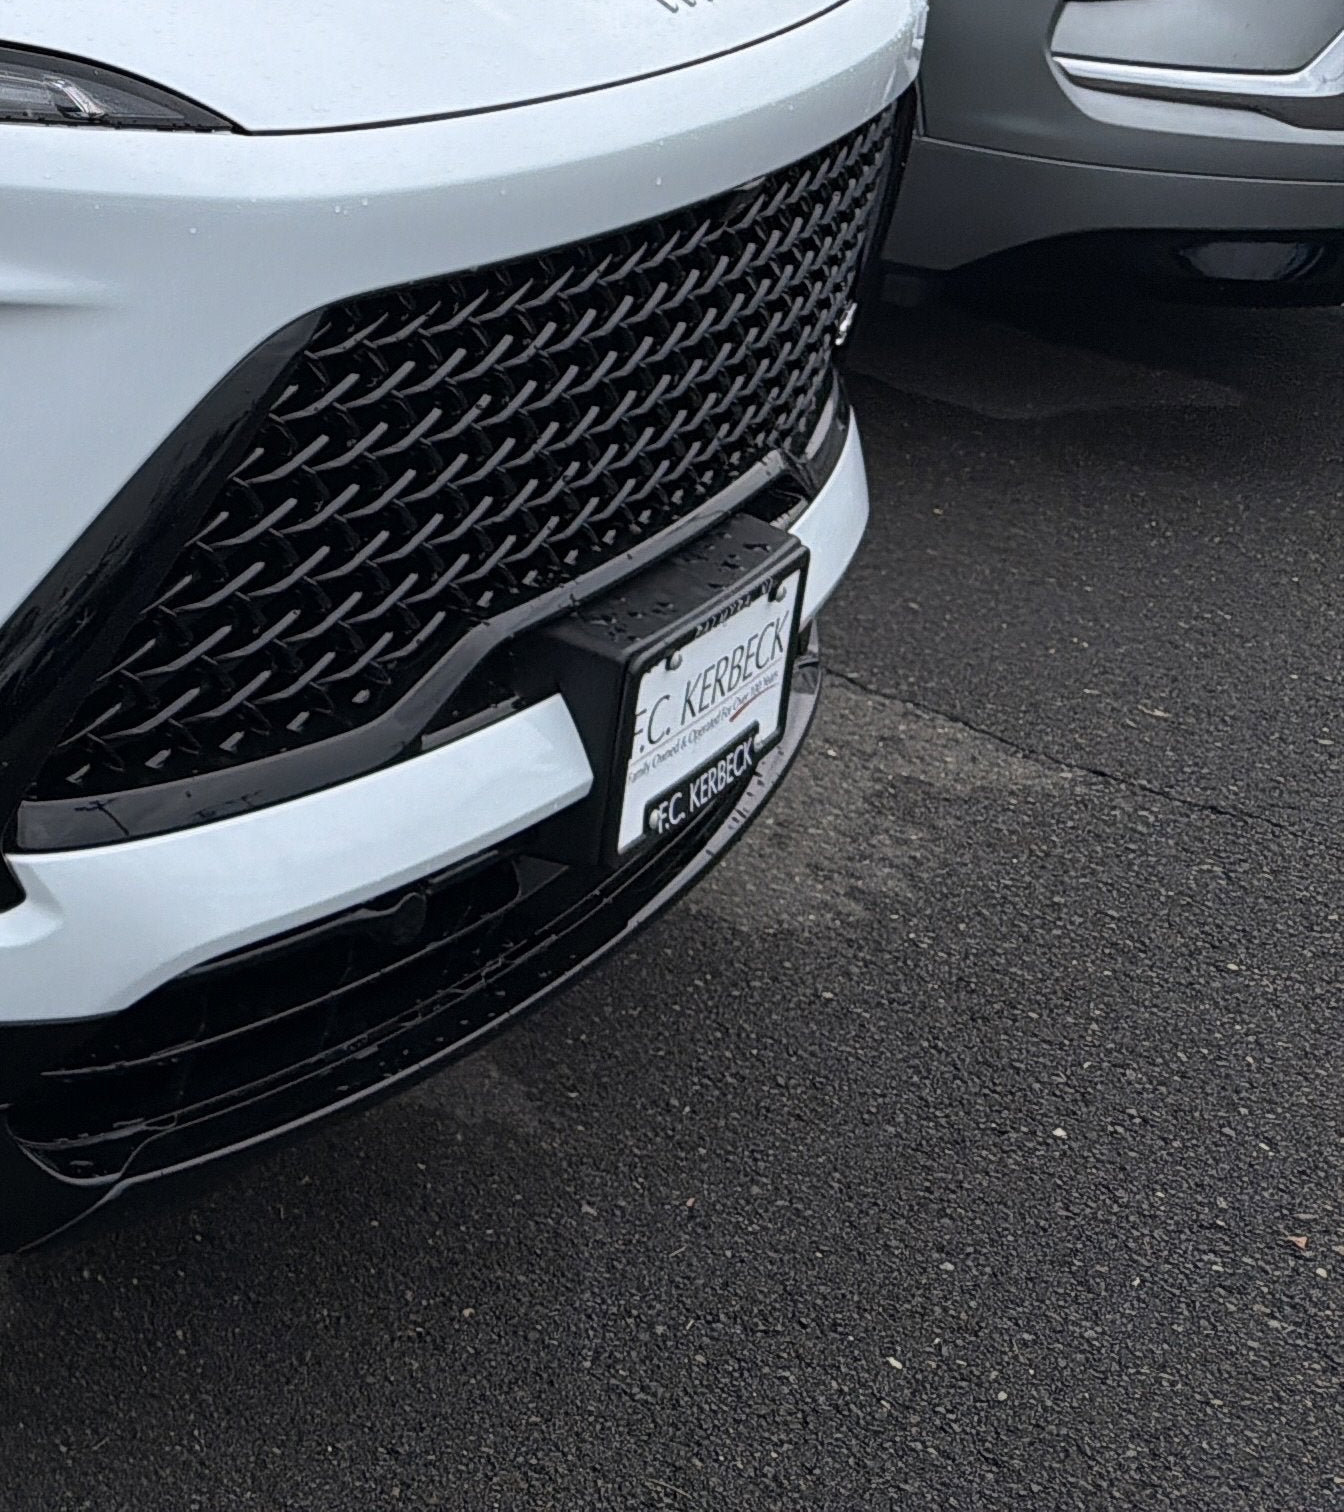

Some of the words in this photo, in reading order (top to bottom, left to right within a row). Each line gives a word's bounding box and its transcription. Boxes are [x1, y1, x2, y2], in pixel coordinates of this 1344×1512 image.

[634, 694, 671, 753] F.C.
[680, 610, 790, 726] KERBECK
[652, 739, 680, 769] Owned
[688, 711, 722, 744] Operated
[732, 692, 749, 711] Over
[689, 737, 753, 813] KERBECK
